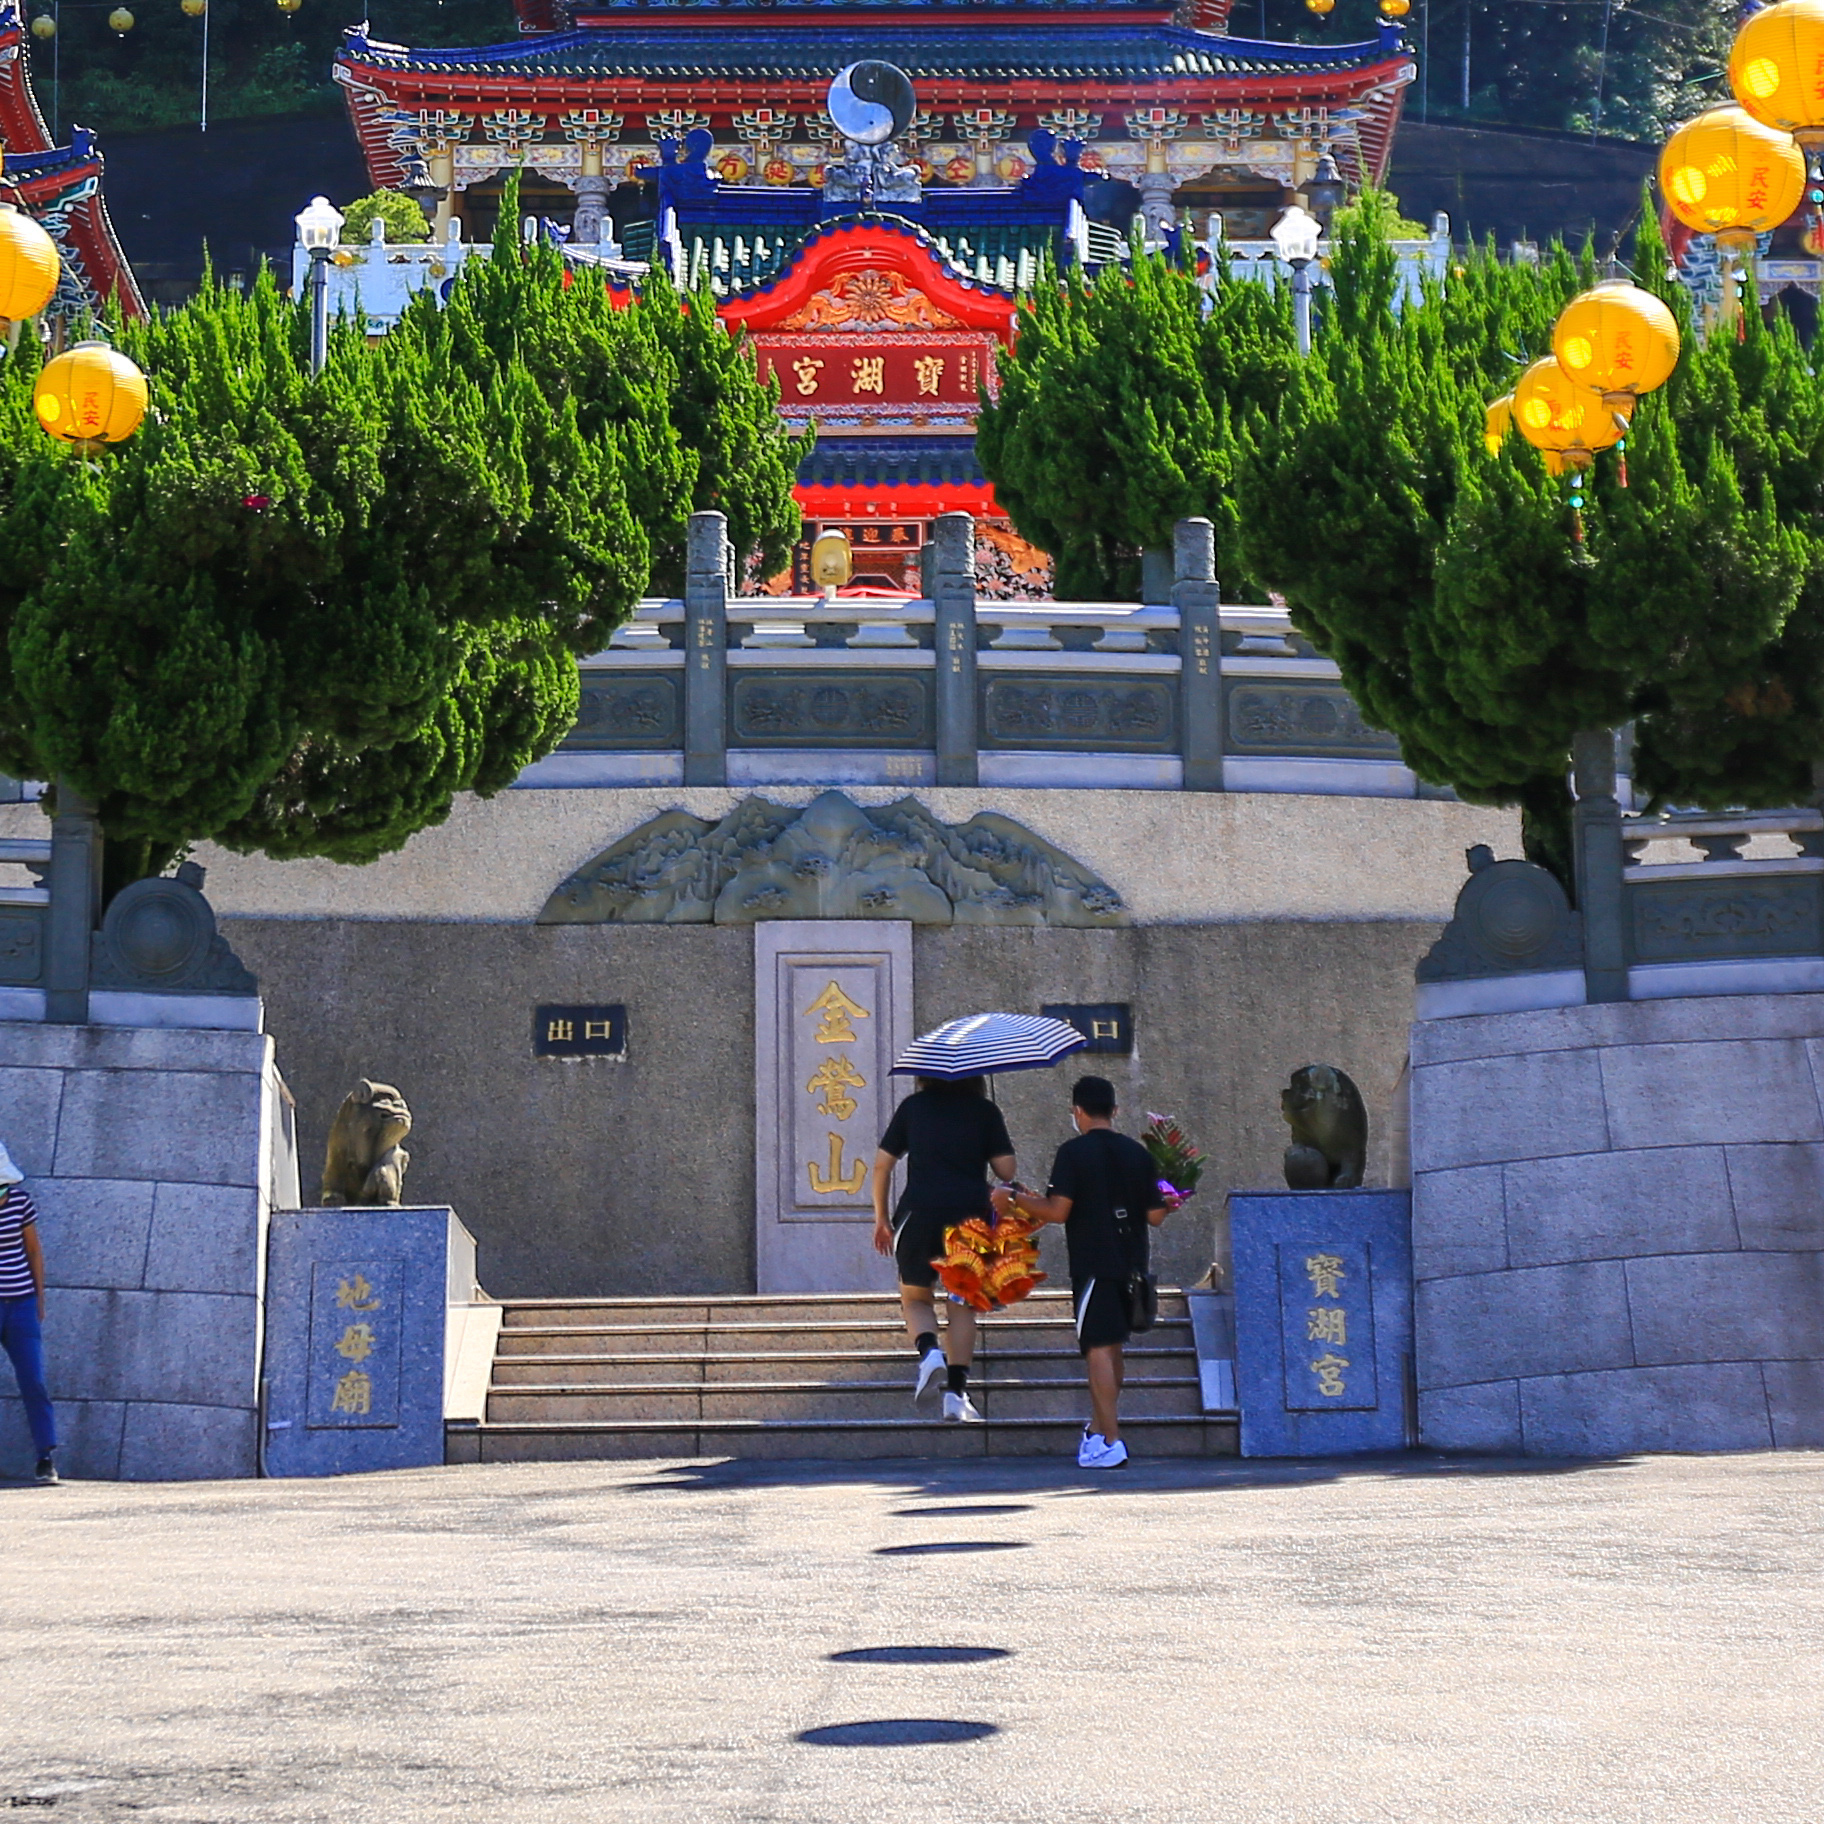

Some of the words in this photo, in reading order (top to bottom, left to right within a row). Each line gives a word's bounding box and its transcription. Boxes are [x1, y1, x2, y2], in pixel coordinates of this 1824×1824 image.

[1746, 167, 1770, 210] 民安
[792, 355, 945, 396] 寶湖宮
[82, 392, 100, 427] 民安
[548, 1020, 610, 1042] 出口
[803, 980, 871, 1195] 金鶯山
[331, 1274, 381, 1415] 地母廟
[1306, 1254, 1350, 1397] 寶湖宮
